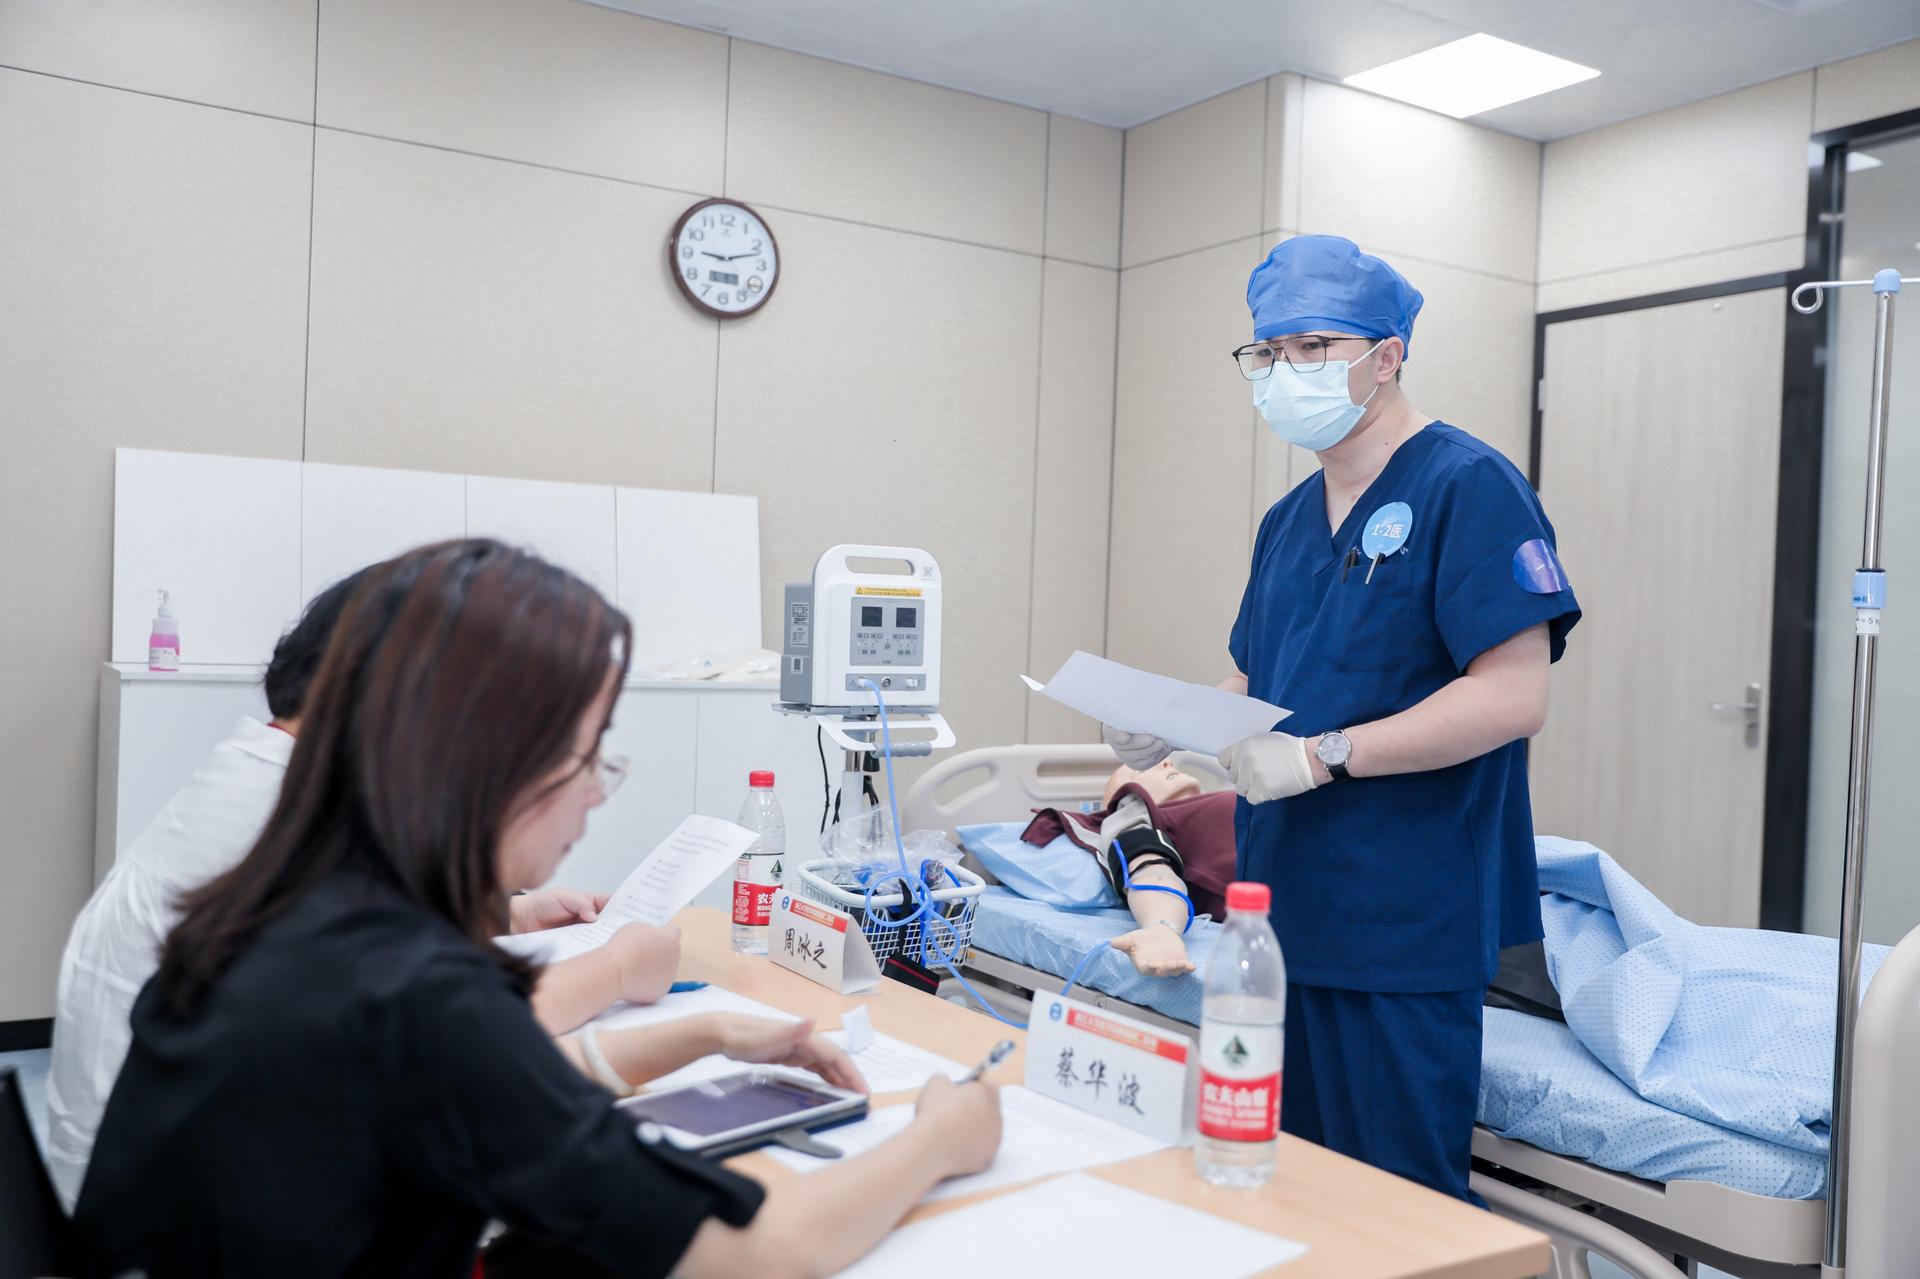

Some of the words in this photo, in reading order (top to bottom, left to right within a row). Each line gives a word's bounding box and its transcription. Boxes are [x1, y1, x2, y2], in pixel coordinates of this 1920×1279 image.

[702, 215, 715, 229] 11
[720, 213, 736, 227] 12
[687, 228, 705, 242] 10
[742, 222, 748, 235] 1
[682, 246, 694, 259] 9
[751, 239, 762, 255] 2
[756, 259, 767, 272] 3
[686, 267, 698, 280] 8
[702, 283, 712, 297] 7
[736, 289, 748, 303] 5
[717, 292, 729, 305] 6
[784, 928, 827, 969] 周冰之
[1055, 1047, 1145, 1116] 蔡华波
